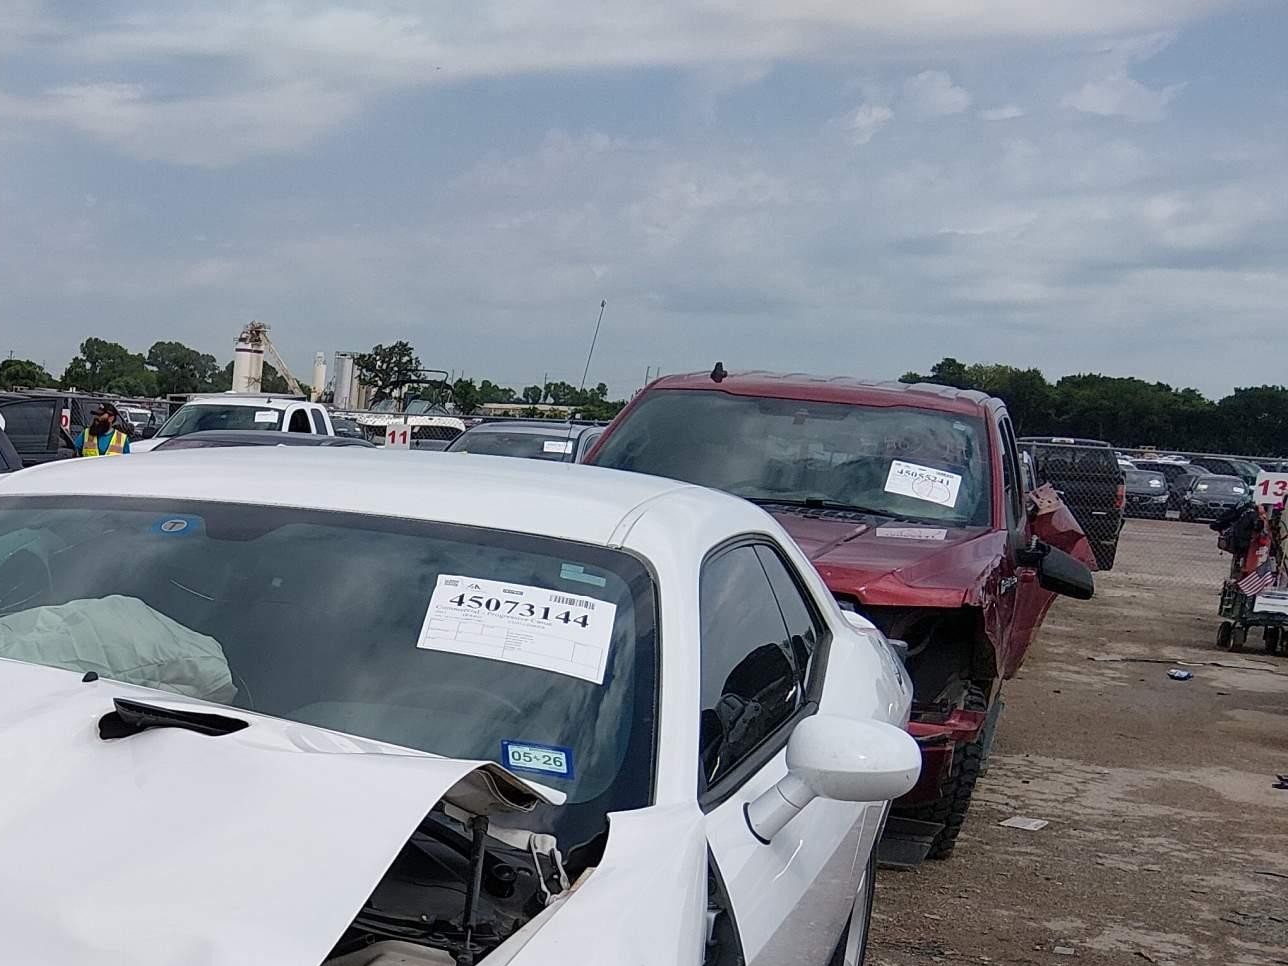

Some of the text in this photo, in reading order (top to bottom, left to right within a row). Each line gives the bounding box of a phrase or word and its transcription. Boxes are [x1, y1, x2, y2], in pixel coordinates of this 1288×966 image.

[388, 430, 408, 444] 11
[1258, 479, 1288, 497] 13
[449, 593, 590, 628] 45073144
